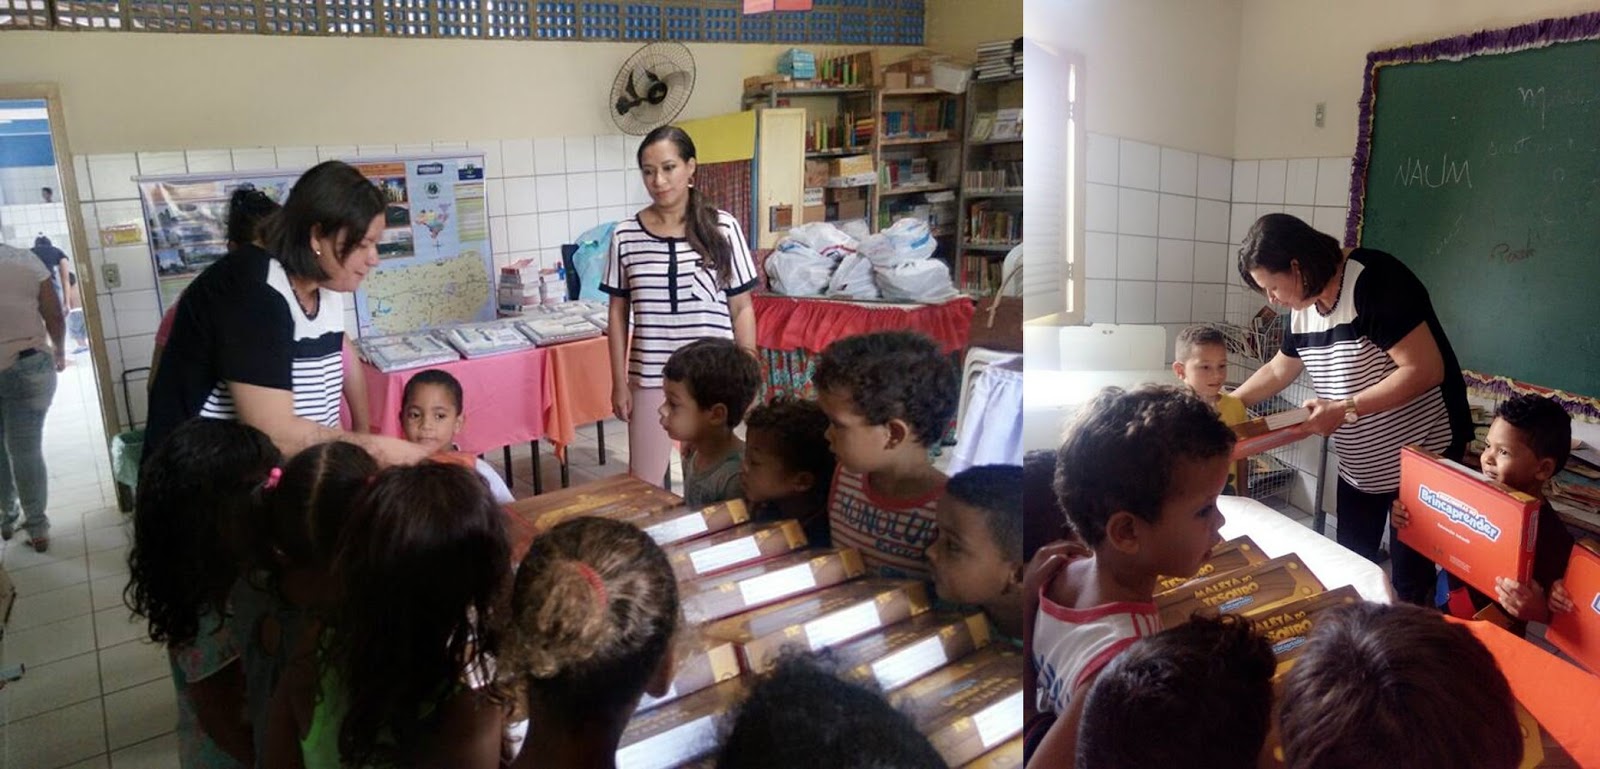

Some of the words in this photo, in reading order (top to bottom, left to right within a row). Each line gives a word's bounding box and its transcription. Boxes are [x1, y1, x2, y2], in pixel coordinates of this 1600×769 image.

[1420, 486, 1498, 541] Brincaprender
[1194, 576, 1240, 600] MALETA
[1202, 581, 1259, 607] TESOURO
[1254, 612, 1293, 632] ALETA
[1264, 618, 1313, 642] SOURO
